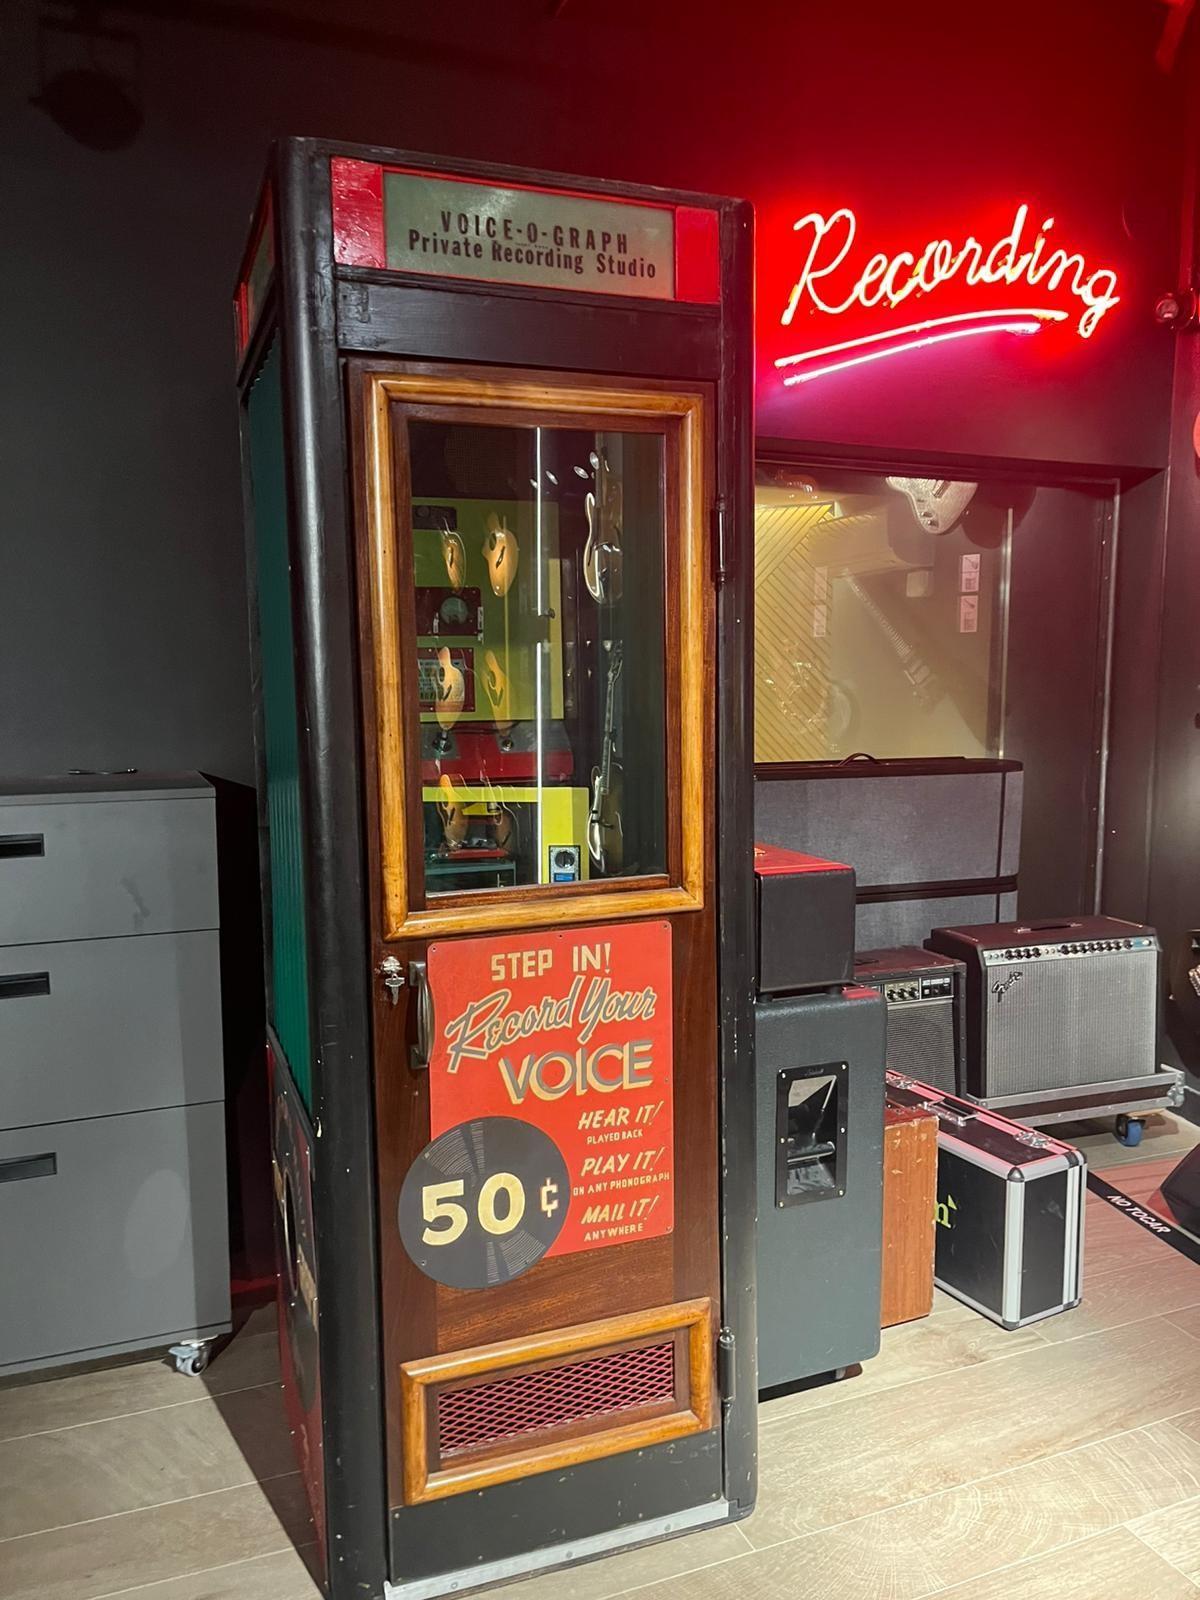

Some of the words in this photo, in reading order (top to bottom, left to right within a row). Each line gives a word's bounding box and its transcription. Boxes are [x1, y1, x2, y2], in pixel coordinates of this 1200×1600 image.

[440, 210, 628, 255] VOICE-O-GRAPH
[408, 228, 484, 259] Private
[491, 240, 584, 275] Recording
[596, 252, 656, 278] Studio
[779, 203, 1121, 339] Recording
[491, 948, 553, 981] STEP
[572, 942, 612, 974] IN!
[444, 974, 584, 1074] Record
[576, 975, 657, 1045] Your
[498, 1039, 654, 1105] VOICE
[577, 1106, 631, 1131] HEAR
[635, 1100, 665, 1126] IT!
[586, 1131, 621, 1145] PLAYED
[621, 1128, 644, 1140] BACK
[580, 1153, 631, 1177] PLAY
[632, 1146, 666, 1172] IT!
[573, 1186, 585, 1197] ON
[587, 1182, 609, 1195] ANY
[609, 1171, 670, 1191] PHONOGRAPH
[580, 1203, 627, 1225] MAIL
[629, 1195, 660, 1221] IT!
[1106, 1195, 1133, 1207] NO
[1125, 1206, 1172, 1233] TOCAR
[583, 1222, 645, 1242] ANYWHERE
